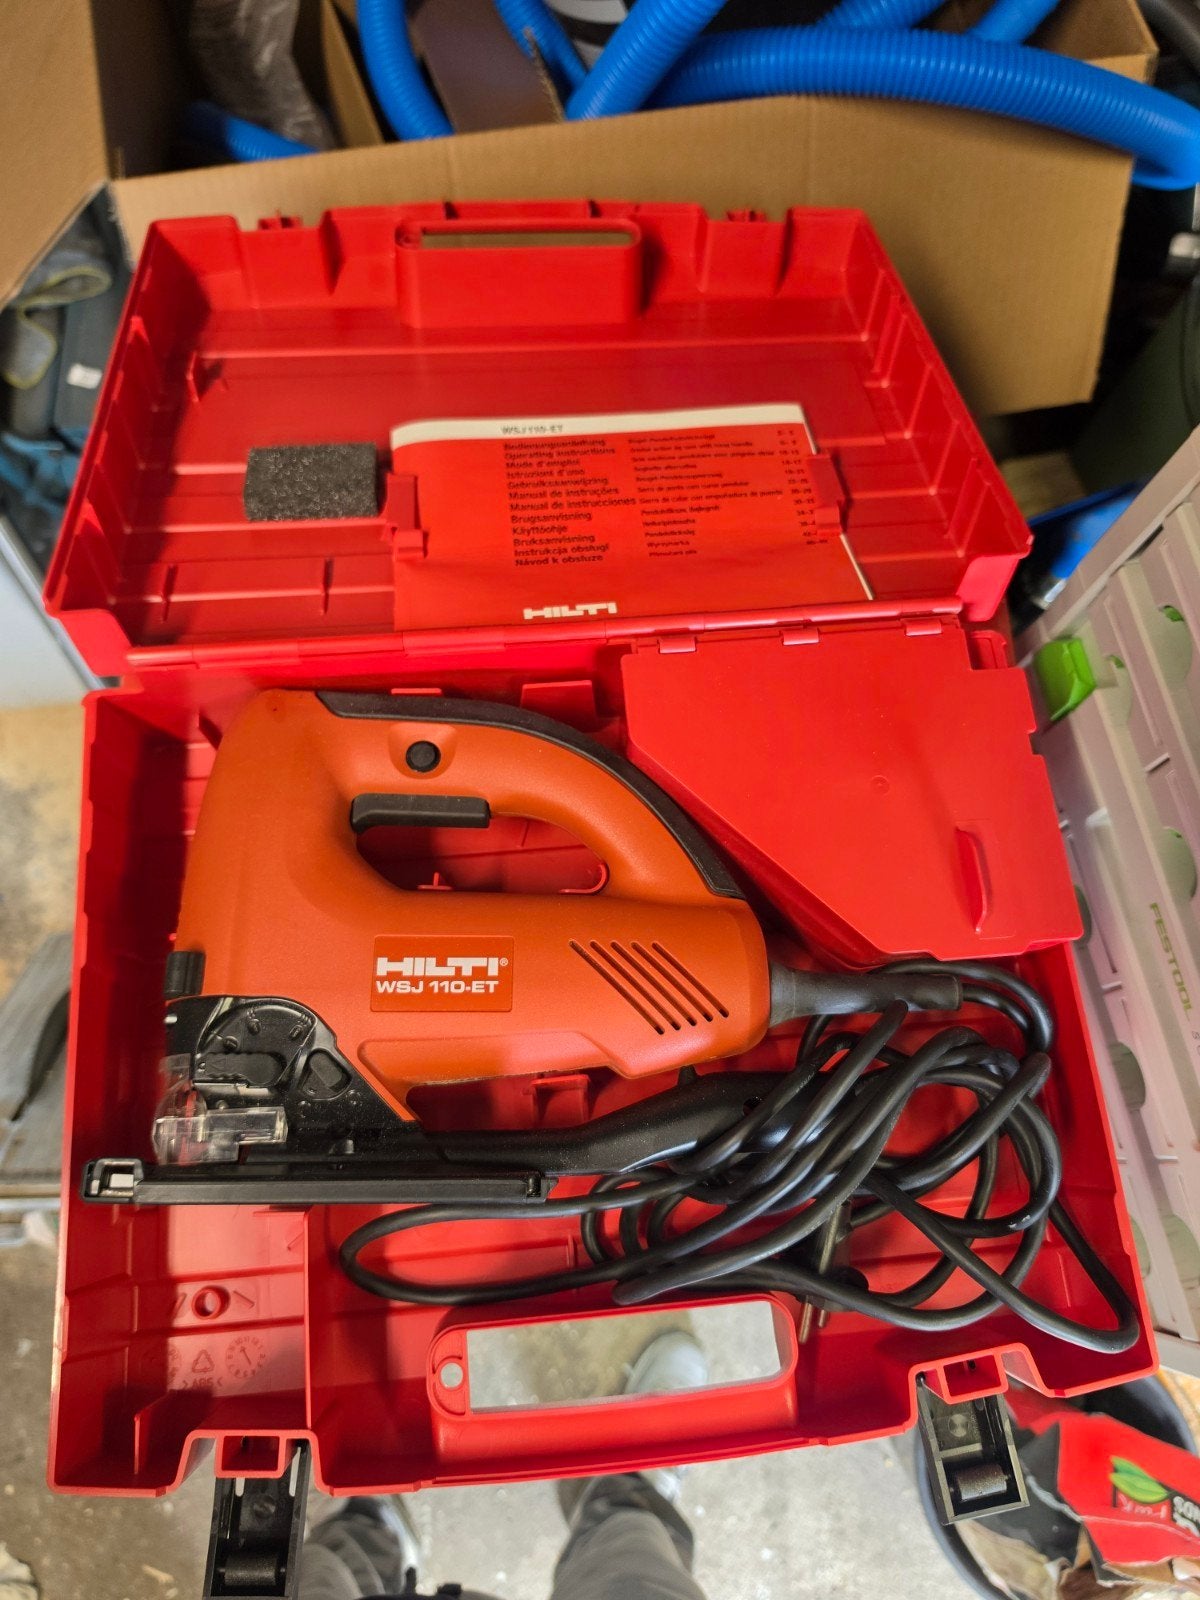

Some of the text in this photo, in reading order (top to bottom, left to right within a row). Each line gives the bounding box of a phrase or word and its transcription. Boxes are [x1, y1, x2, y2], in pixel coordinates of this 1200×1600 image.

[523, 601, 617, 620] HILTI
[376, 980, 499, 993] WSJ 110-ET
